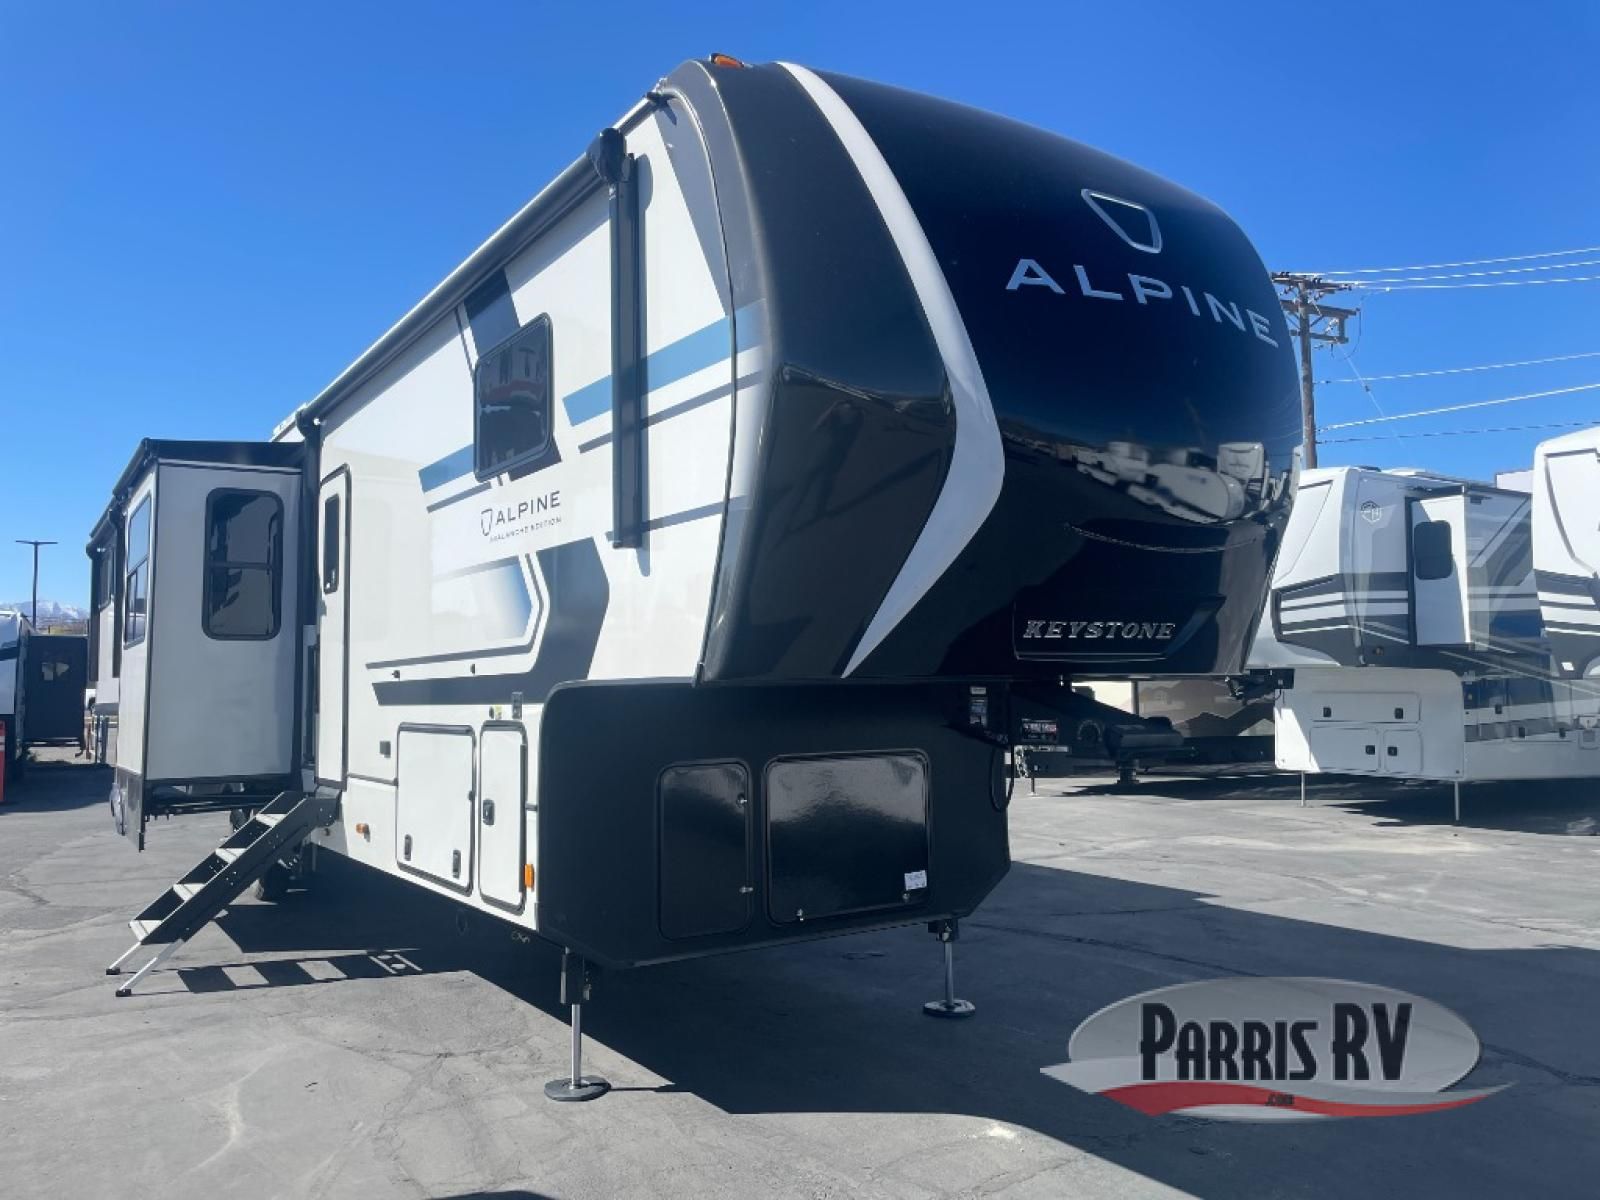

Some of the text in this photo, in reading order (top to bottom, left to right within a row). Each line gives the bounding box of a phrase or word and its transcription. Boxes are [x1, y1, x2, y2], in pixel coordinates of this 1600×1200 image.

[1005, 258, 1279, 348] ALPINE
[495, 490, 561, 525] ALPINE
[1023, 619, 1176, 640] KEYSTONE
